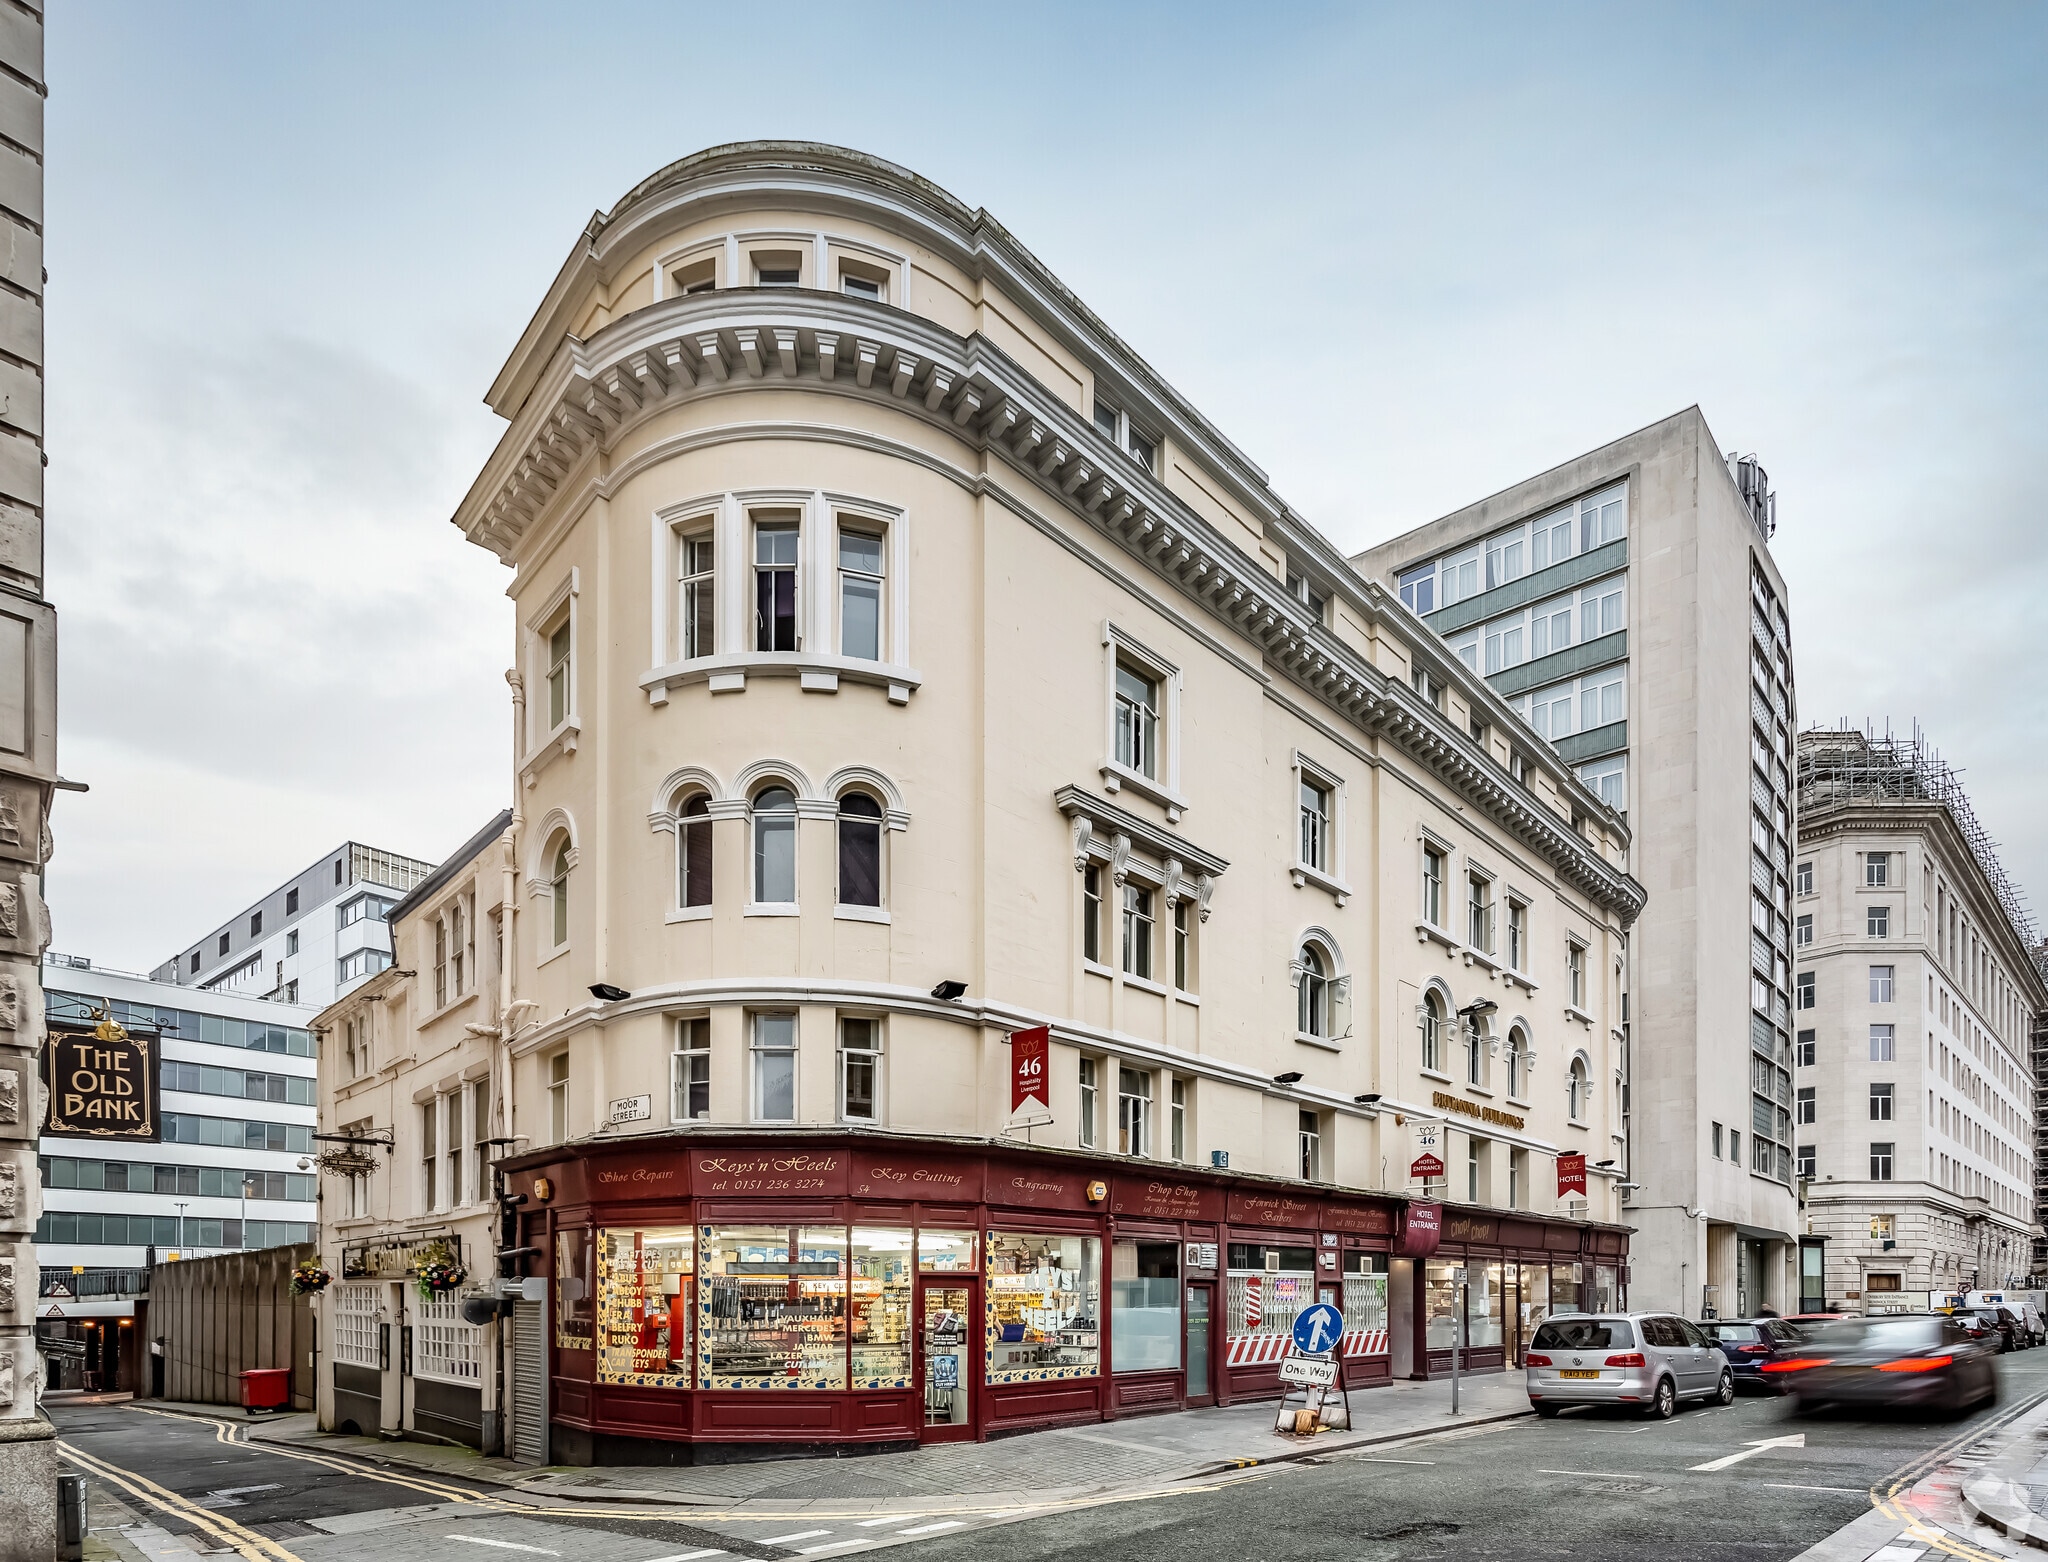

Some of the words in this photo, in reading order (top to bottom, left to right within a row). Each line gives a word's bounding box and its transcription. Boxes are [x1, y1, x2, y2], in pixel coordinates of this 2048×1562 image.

[72, 1044, 131, 1072] THE
[1018, 1055, 1042, 1077] 46
[71, 1069, 133, 1096] OLD
[1019, 1077, 1042, 1086] Hospitality
[1020, 1084, 1040, 1093] Liverpool
[64, 1093, 141, 1121] BANK
[617, 1099, 638, 1111] MOOR
[1432, 1090, 1482, 1118] BRITANNIA
[1481, 1106, 1525, 1130] BUILDINGS
[612, 1109, 638, 1122] STREET
[1419, 1136, 1436, 1145] 46
[1412, 1164, 1442, 1172] ENTRANCE
[598, 1171, 629, 1183] Shoe
[632, 1168, 674, 1183] Repairs
[870, 1167, 907, 1184] Key
[912, 1169, 963, 1187] Cutting
[1559, 1174, 1585, 1184] HOTEL
[712, 1180, 728, 1190] tel.
[734, 1180, 762, 1190] 0151
[766, 1179, 791, 1190] 236
[794, 1178, 825, 1190] 3274
[857, 1184, 871, 1195] 54
[1011, 1177, 1064, 1195] Engraving
[1148, 1182, 1173, 1198] Chop
[1175, 1185, 1198, 1200] Chop
[1244, 1196, 1279, 1210] Fenwick
[1281, 1199, 1307, 1211] Street
[1154, 1206, 1169, 1215] 0151
[1170, 1207, 1183, 1216] 227
[1184, 1209, 1200, 1217] 9999
[1260, 1211, 1293, 1223] Barbers
[1416, 1209, 1434, 1220] HOTEL
[1409, 1219, 1439, 1231] ENTRANCE
[1450, 1217, 1471, 1238] Chop!
[1470, 1224, 1490, 1241] Chop!
[635, 1250, 662, 1260] TYPES
[364, 1251, 379, 1272] THE
[641, 1260, 661, 1271] CUT
[612, 1272, 638, 1284] ABUS
[1024, 1266, 1074, 1292] KEYS
[612, 1286, 643, 1296] ABLOY
[813, 1282, 827, 1290] KEY
[611, 1298, 643, 1309] CHUBB
[1264, 1304, 1294, 1314] BARBER
[611, 1310, 631, 1320] ERA
[780, 1315, 834, 1323] VAUXHALL
[1020, 1304, 1077, 1332] HEELS
[611, 1323, 643, 1333] BELFRY
[782, 1324, 835, 1332] MERCEDES
[611, 1334, 639, 1345] RUKO
[807, 1334, 835, 1342] BMW
[792, 1343, 834, 1351] JAGUAR
[611, 1347, 668, 1359] TRANSPONDER
[770, 1352, 803, 1360] LAZER
[808, 1352, 835, 1360] KEYS
[610, 1358, 626, 1367] CAR
[630, 1359, 650, 1368] KEYS
[784, 1360, 804, 1368] CUT
[1285, 1364, 1307, 1375] One
[1309, 1366, 1333, 1380] Way
